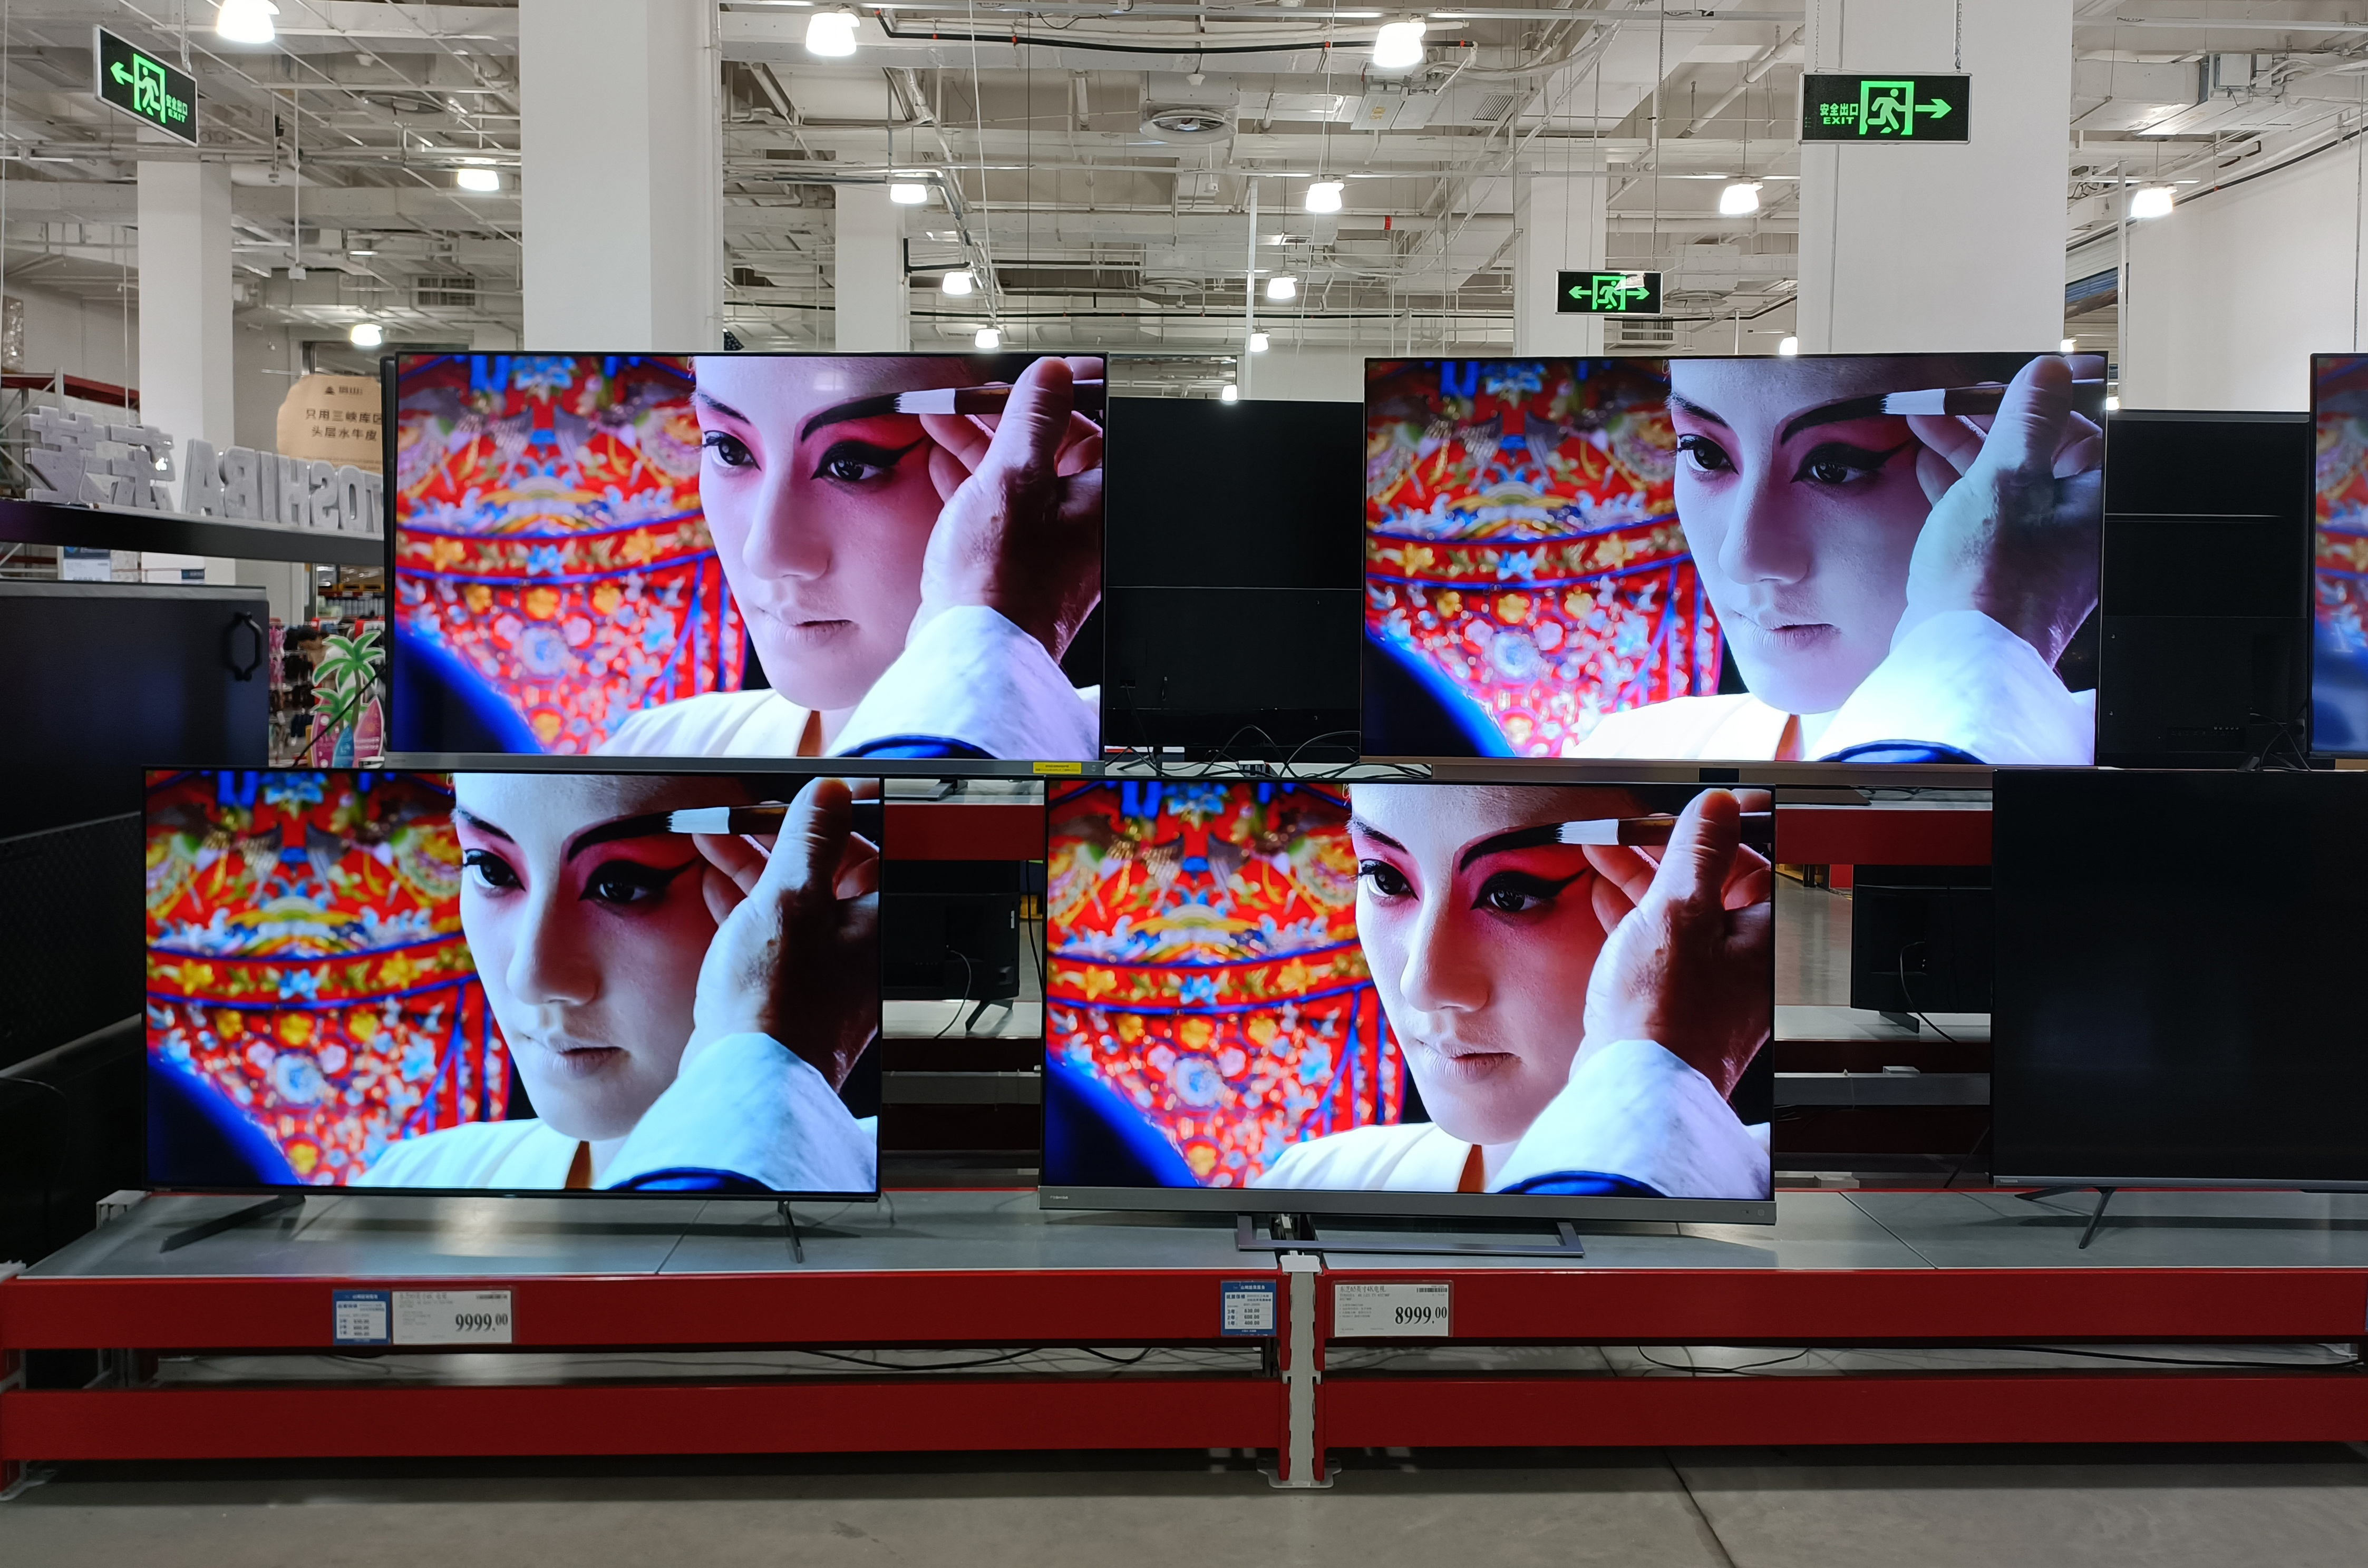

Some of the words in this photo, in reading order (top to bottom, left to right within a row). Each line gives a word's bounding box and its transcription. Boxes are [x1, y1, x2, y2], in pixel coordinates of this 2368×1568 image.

[168, 108, 186, 123] EXIT
[1820, 103, 1859, 116] 安全出口
[455, 1313, 508, 1332] 9999.00
[1395, 1306, 1447, 1324] 8999.00
